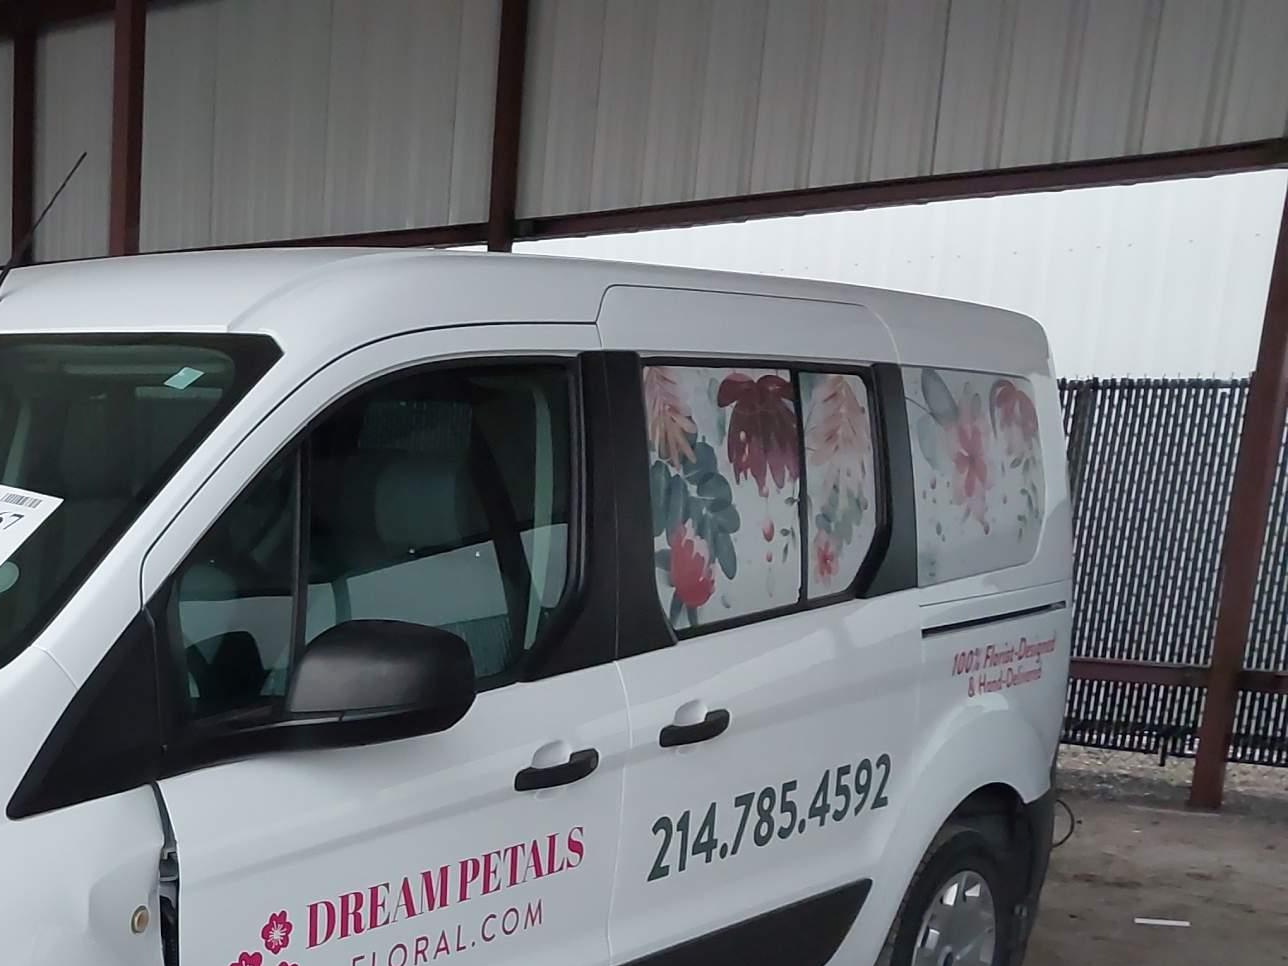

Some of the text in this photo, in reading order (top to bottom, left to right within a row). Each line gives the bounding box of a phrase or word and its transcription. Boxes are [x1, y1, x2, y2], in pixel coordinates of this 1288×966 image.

[647, 753, 891, 882] 214.785.4592
[305, 826, 585, 950] DREAM PETALS
